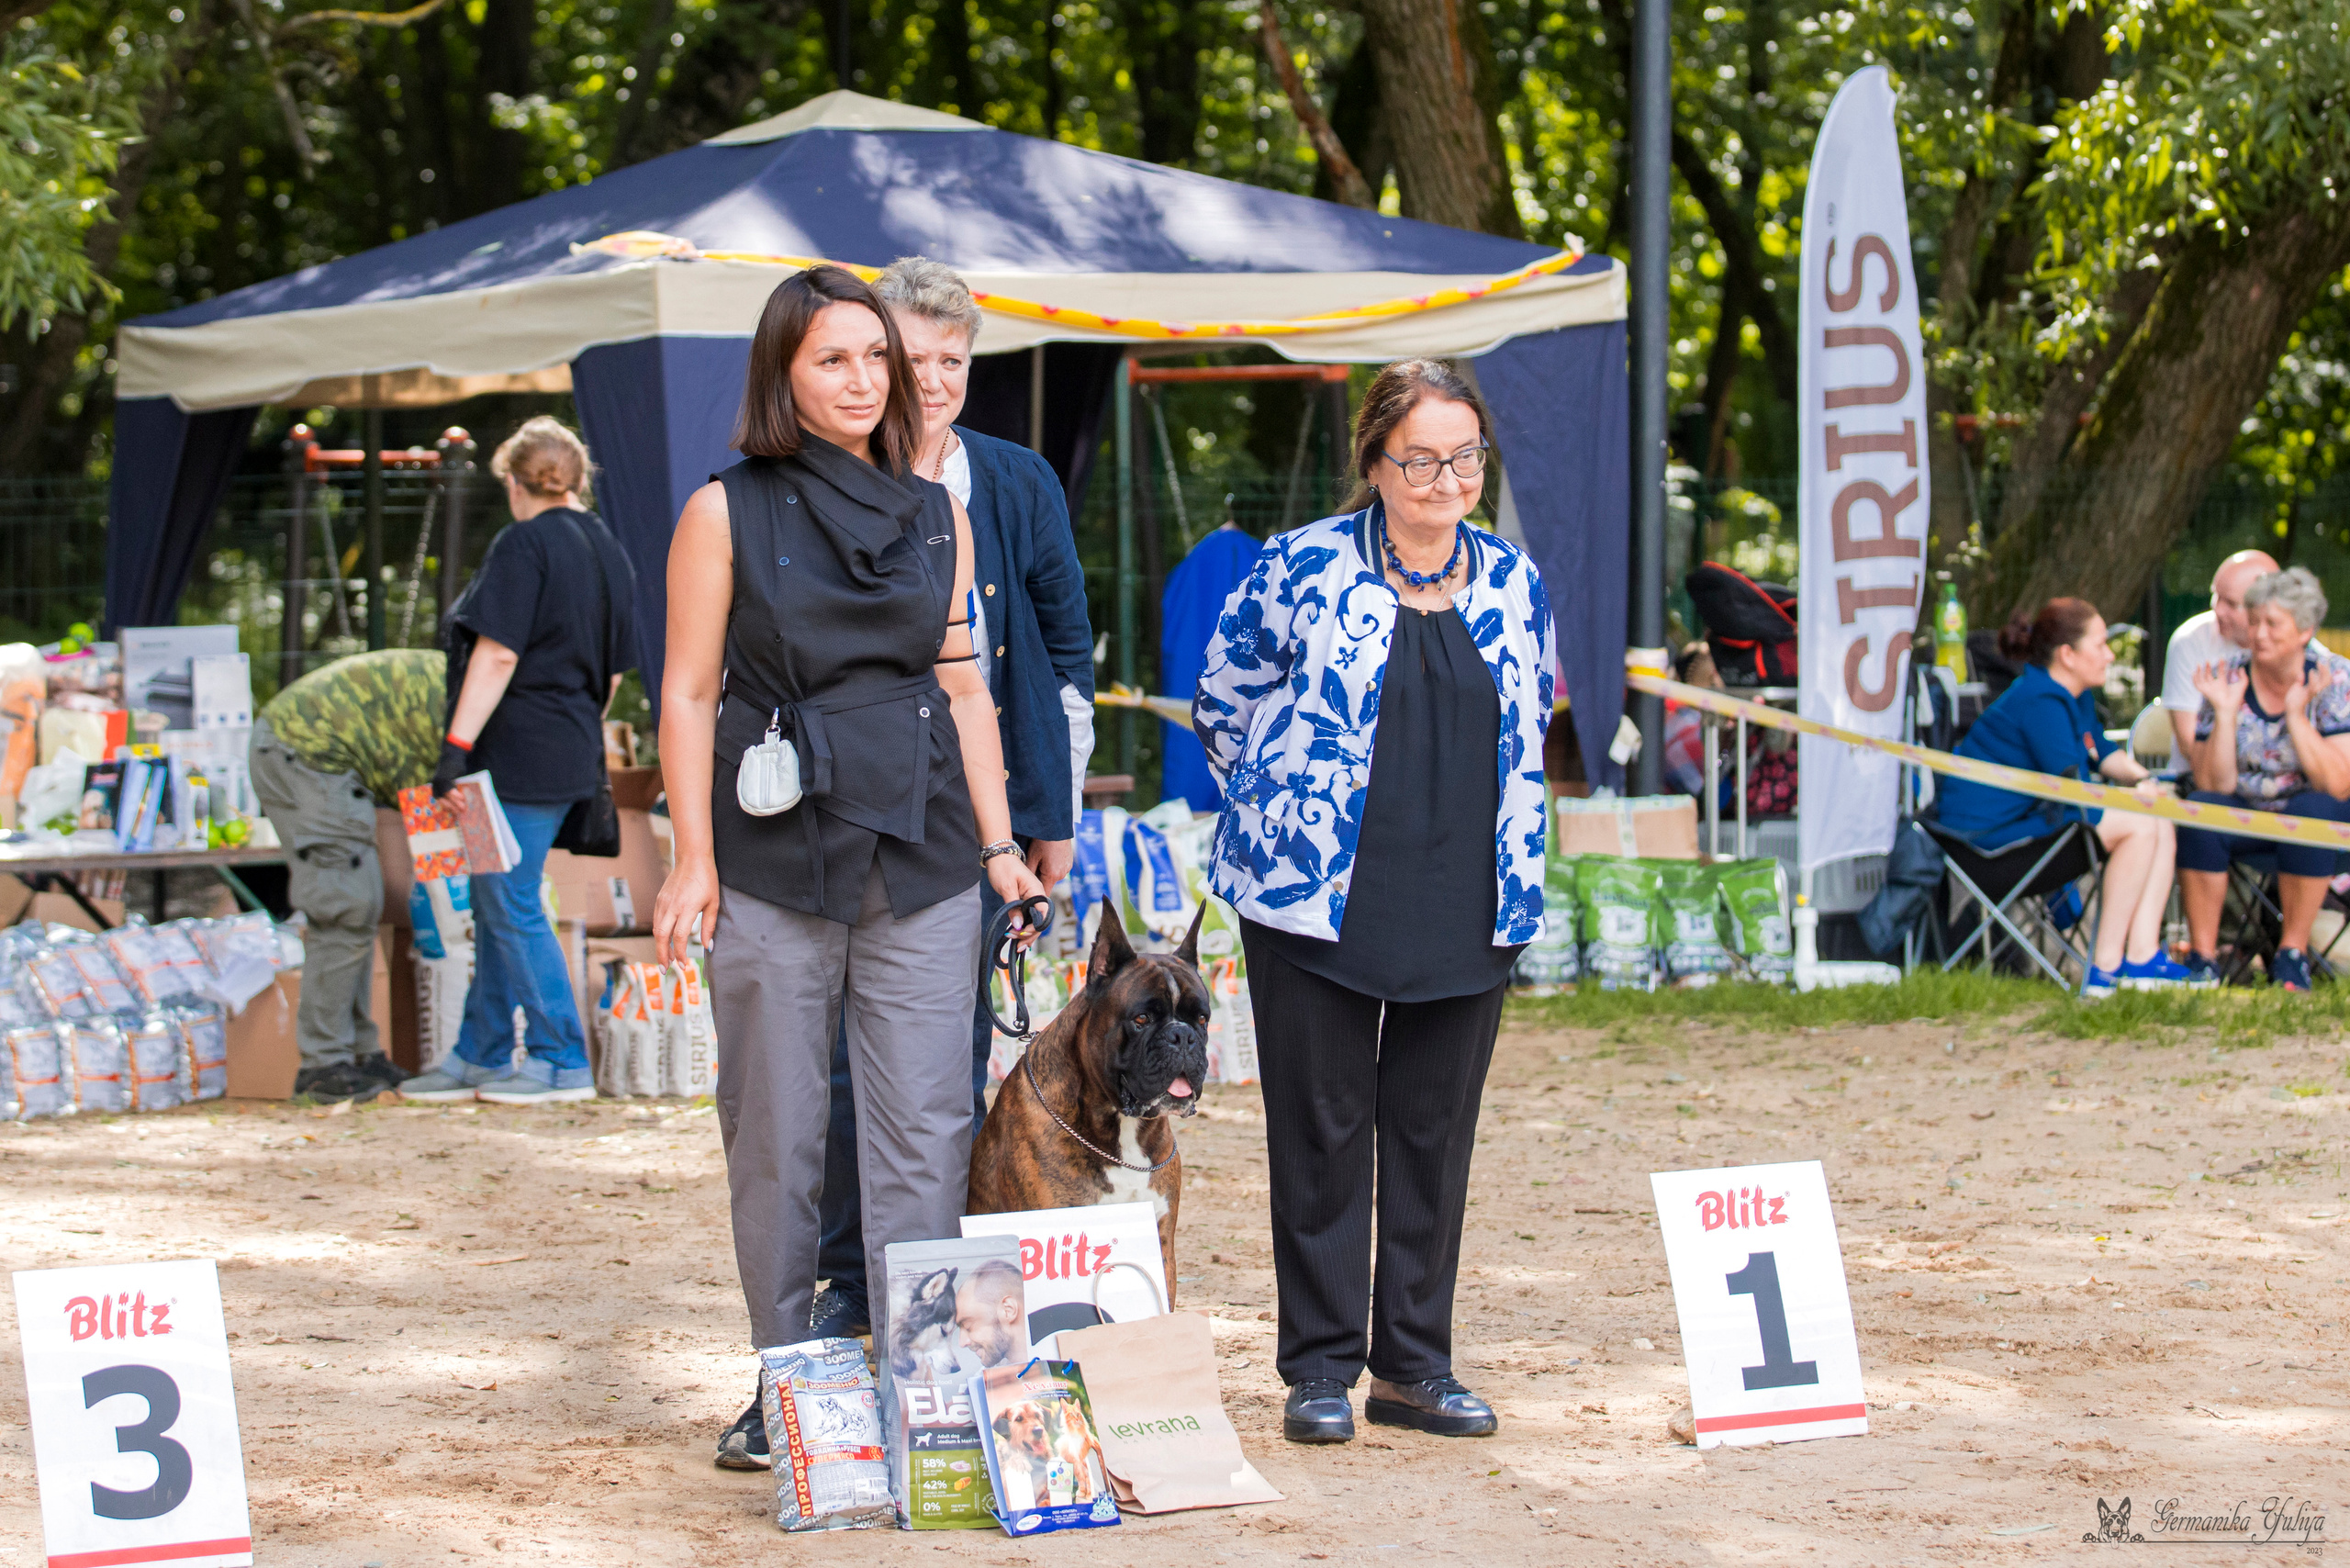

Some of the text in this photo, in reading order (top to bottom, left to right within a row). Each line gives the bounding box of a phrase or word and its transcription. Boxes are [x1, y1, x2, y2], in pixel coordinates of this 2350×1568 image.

[1824, 232, 1921, 713] SIRIUS
[1695, 1184, 1790, 1232] Blitz
[1019, 1231, 1116, 1282] Blitz
[63, 1289, 174, 1343] Blitz
[1725, 1251, 1819, 1391] 1
[808, 1378, 859, 1389] ЗООМЕНЮ
[904, 1383, 977, 1425] Elá
[82, 1363, 193, 1520] 3
[1108, 1415, 1201, 1439] levrana
[923, 1458, 946, 1469] 58%
[923, 1479, 947, 1490] 42%
[923, 1502, 941, 1512] 0%
